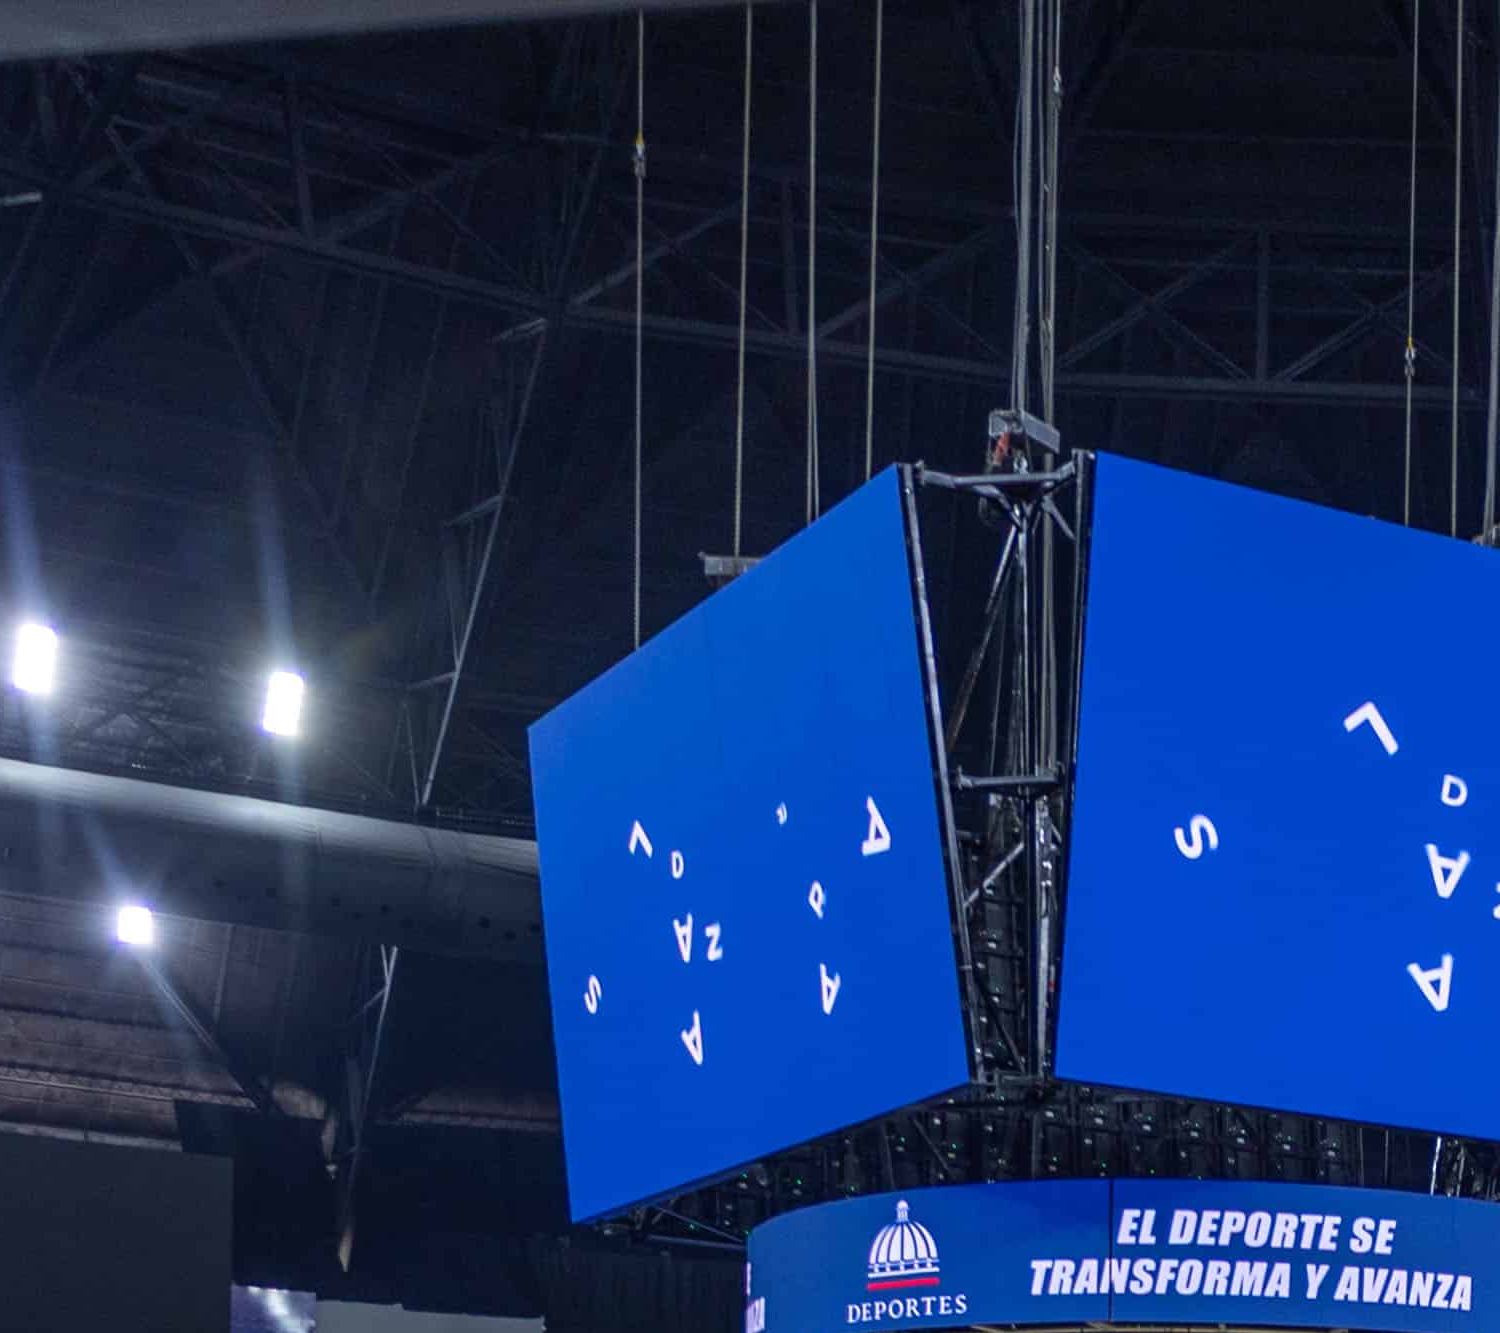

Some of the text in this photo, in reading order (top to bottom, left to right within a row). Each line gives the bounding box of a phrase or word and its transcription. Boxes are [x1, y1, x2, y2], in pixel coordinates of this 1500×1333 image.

[1440, 773, 1468, 807] D
[1174, 813, 1219, 860] S
[1425, 843, 1471, 899] A
[673, 911, 694, 963] A
[819, 961, 841, 1016] A
[1406, 951, 1454, 1013] A
[1116, 1208, 1397, 1255] EL DEPORTE SE
[846, 1293, 968, 1324] DEPORTES
[1029, 1259, 1474, 1312] TRANSFORMA Y AVANZA
